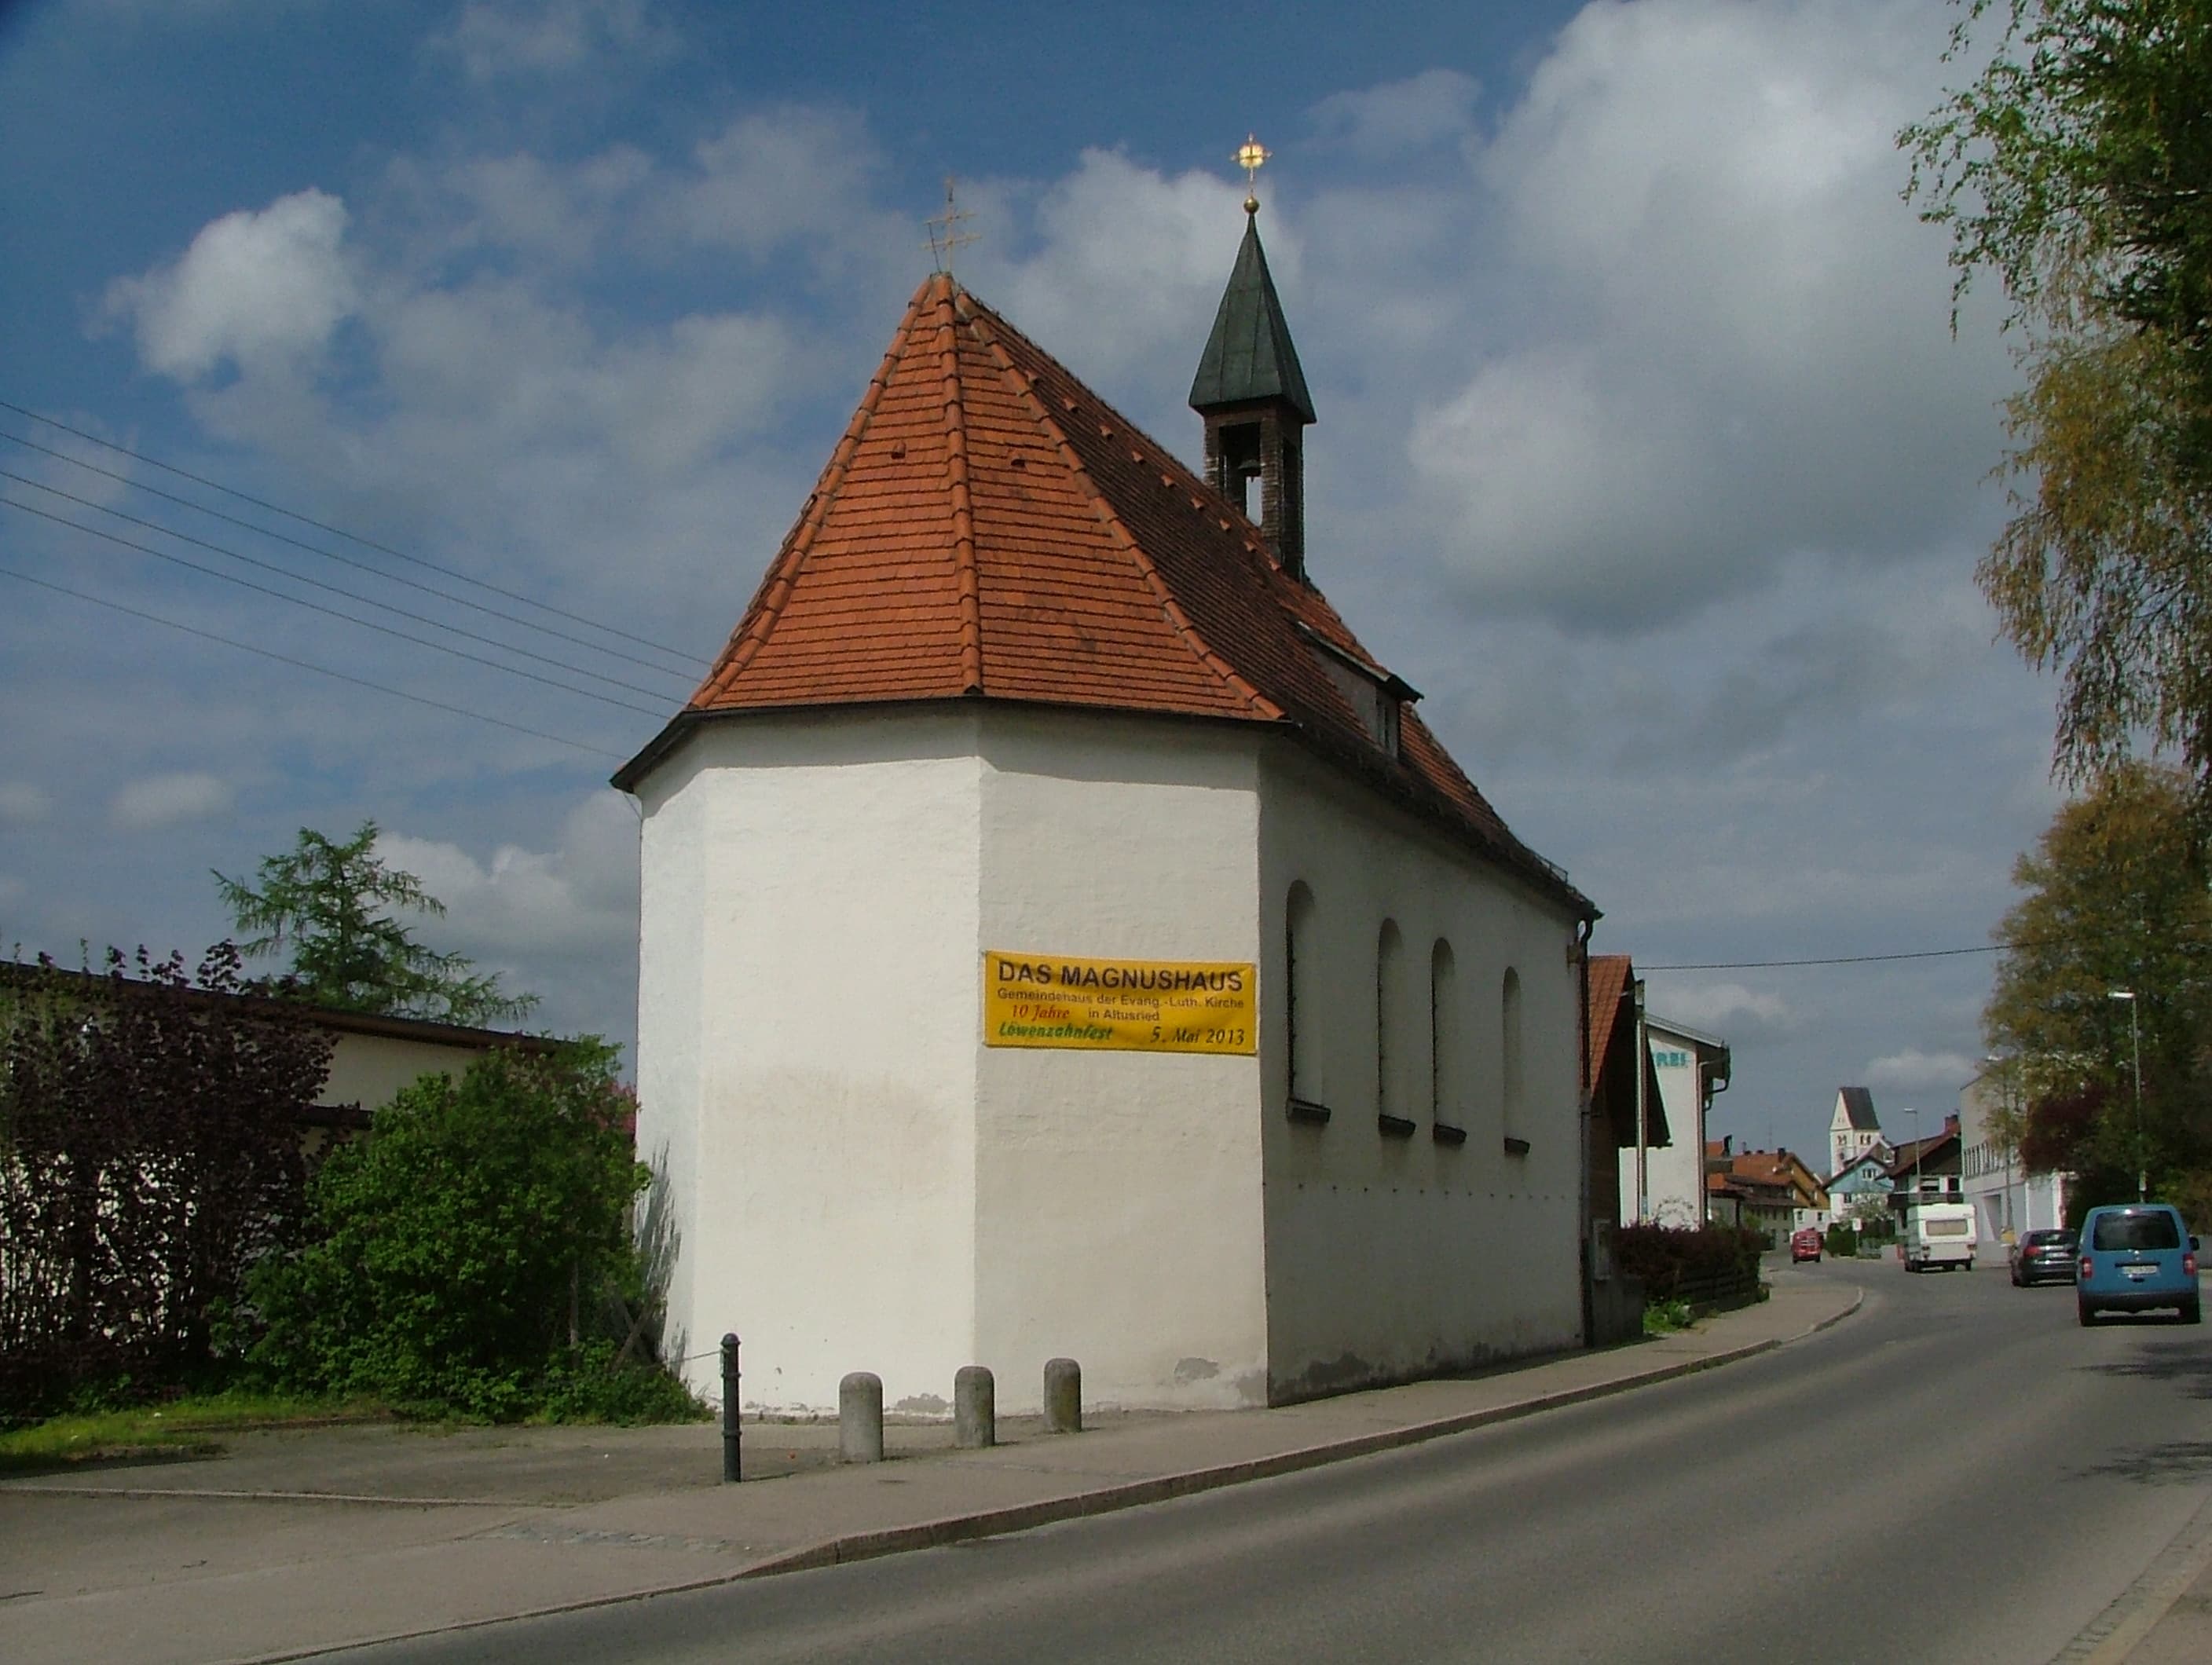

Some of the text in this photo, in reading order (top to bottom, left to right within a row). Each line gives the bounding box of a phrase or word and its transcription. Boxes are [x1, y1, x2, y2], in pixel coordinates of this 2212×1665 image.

[998, 961, 1243, 992] DAS MAGNUSHAUS
[998, 987, 1093, 1004] Gemeindehaus
[1097, 993, 1116, 1004] der
[1205, 997, 1244, 1008] Kirche
[1012, 1004, 1070, 1022] 10 Jahre
[1088, 1007, 1159, 1021] in Altusried
[998, 1021, 1113, 1041] Löwenzahnfest
[1150, 1026, 1244, 1046] 5. Mai 2013
